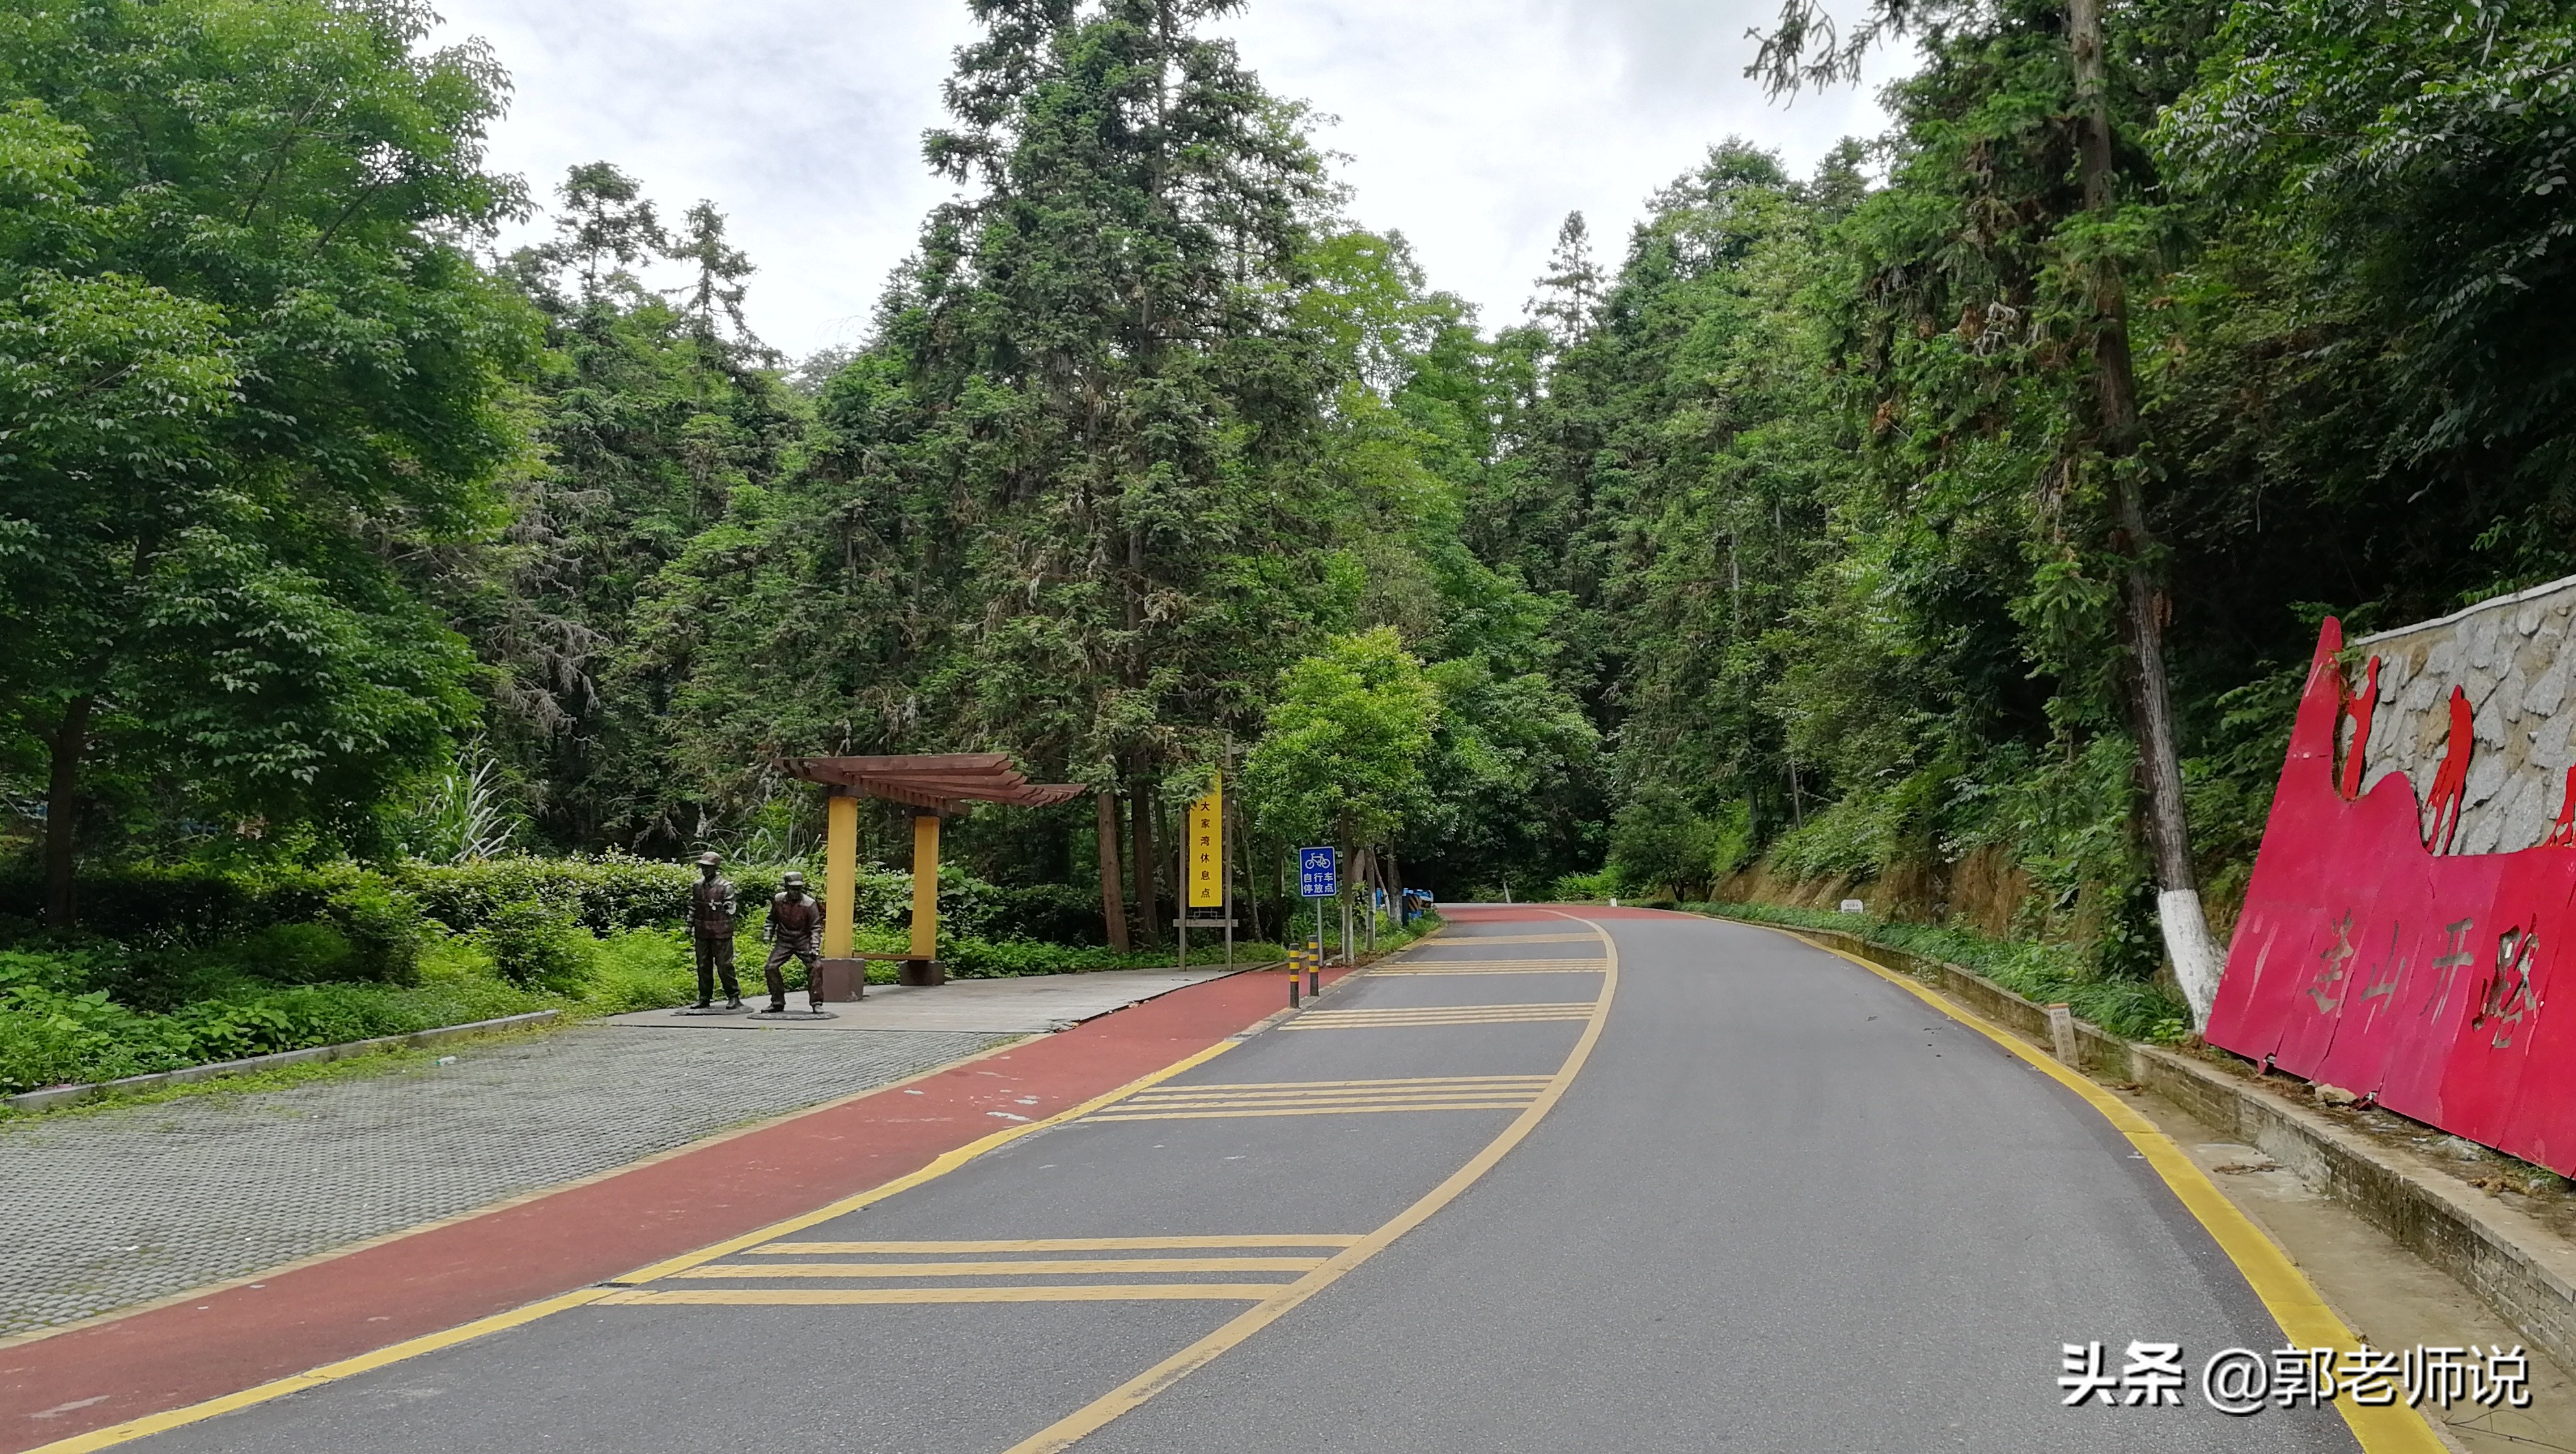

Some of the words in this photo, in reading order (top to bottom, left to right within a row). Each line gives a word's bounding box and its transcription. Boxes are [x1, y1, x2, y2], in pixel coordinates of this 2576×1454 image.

[1200, 801, 1211, 898] 大家湾休息点
[1304, 872, 1333, 883] 自行车
[1304, 883, 1334, 894] 停放点
